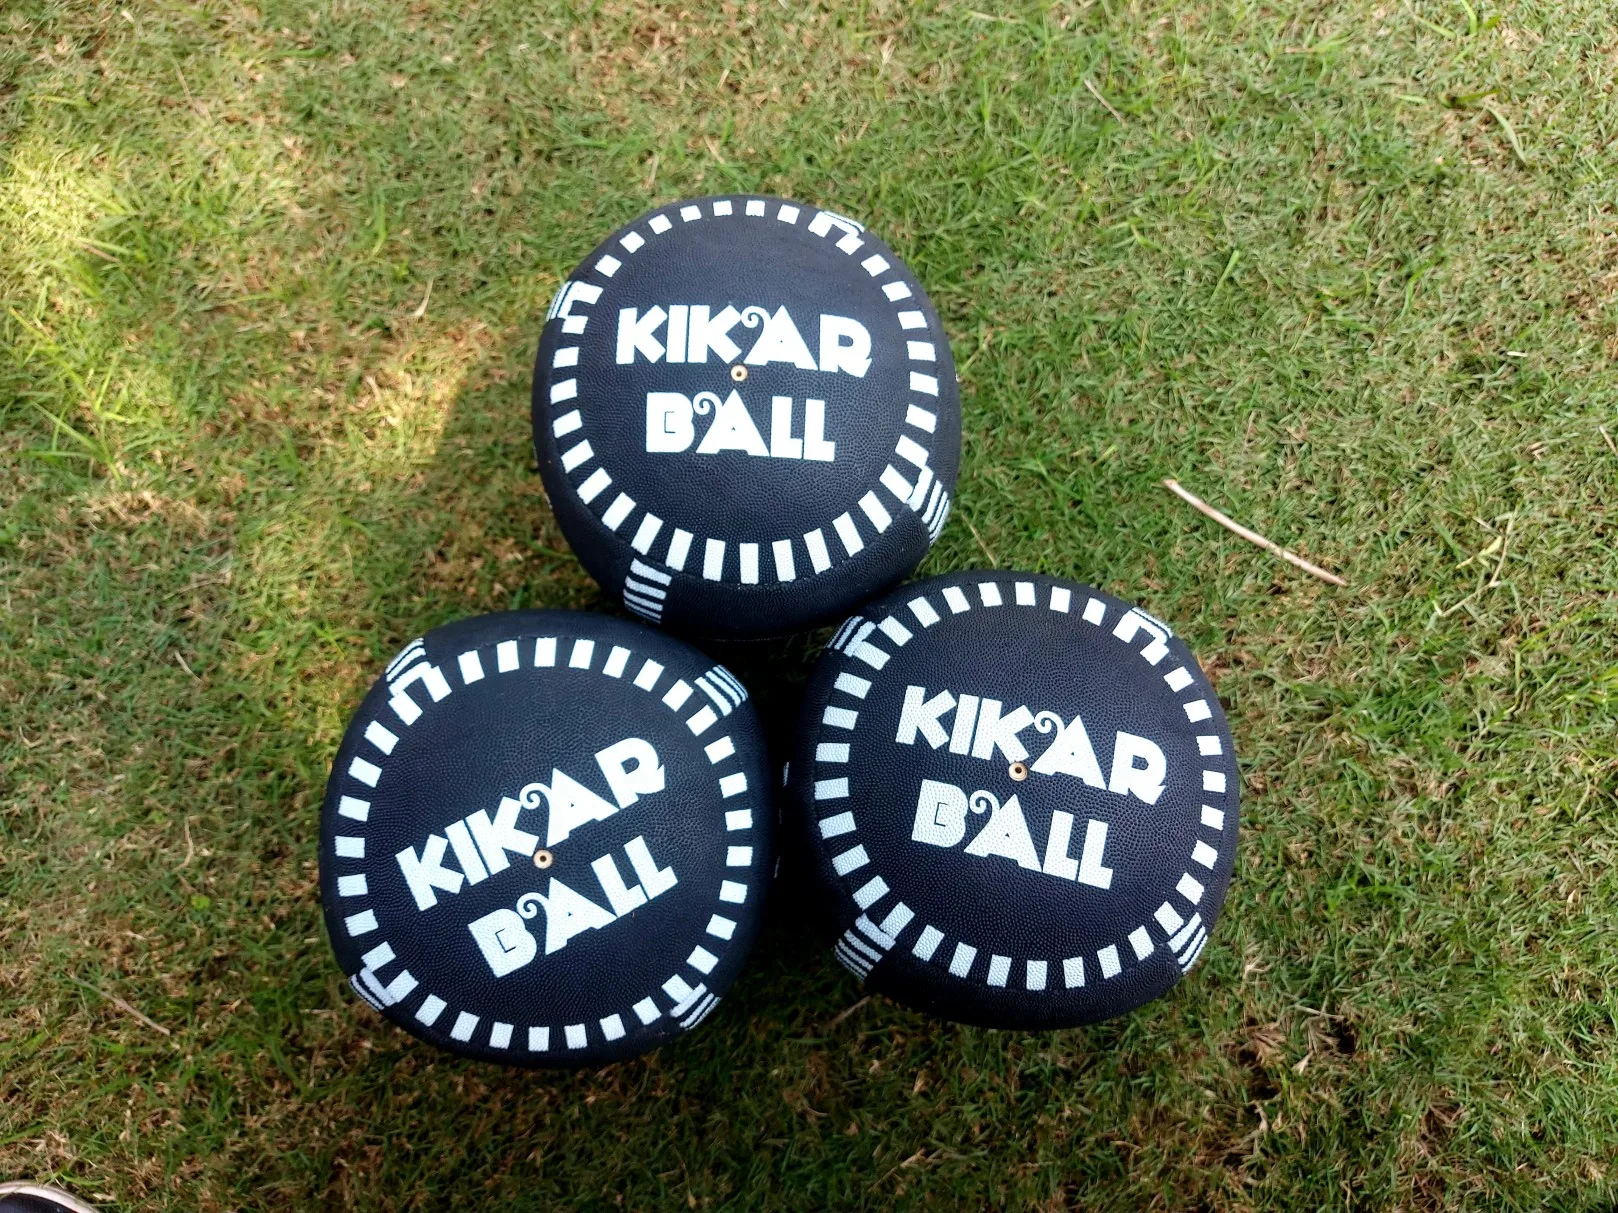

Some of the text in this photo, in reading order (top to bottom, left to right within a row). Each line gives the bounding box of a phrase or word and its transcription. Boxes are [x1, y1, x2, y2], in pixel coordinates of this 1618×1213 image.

[616, 304, 872, 378] KIKAR
[645, 389, 836, 462] BALL
[895, 685, 1167, 805] KIKAR
[395, 737, 665, 911] KIKAR
[911, 779, 1113, 890] BALL
[468, 835, 678, 978] BALL
